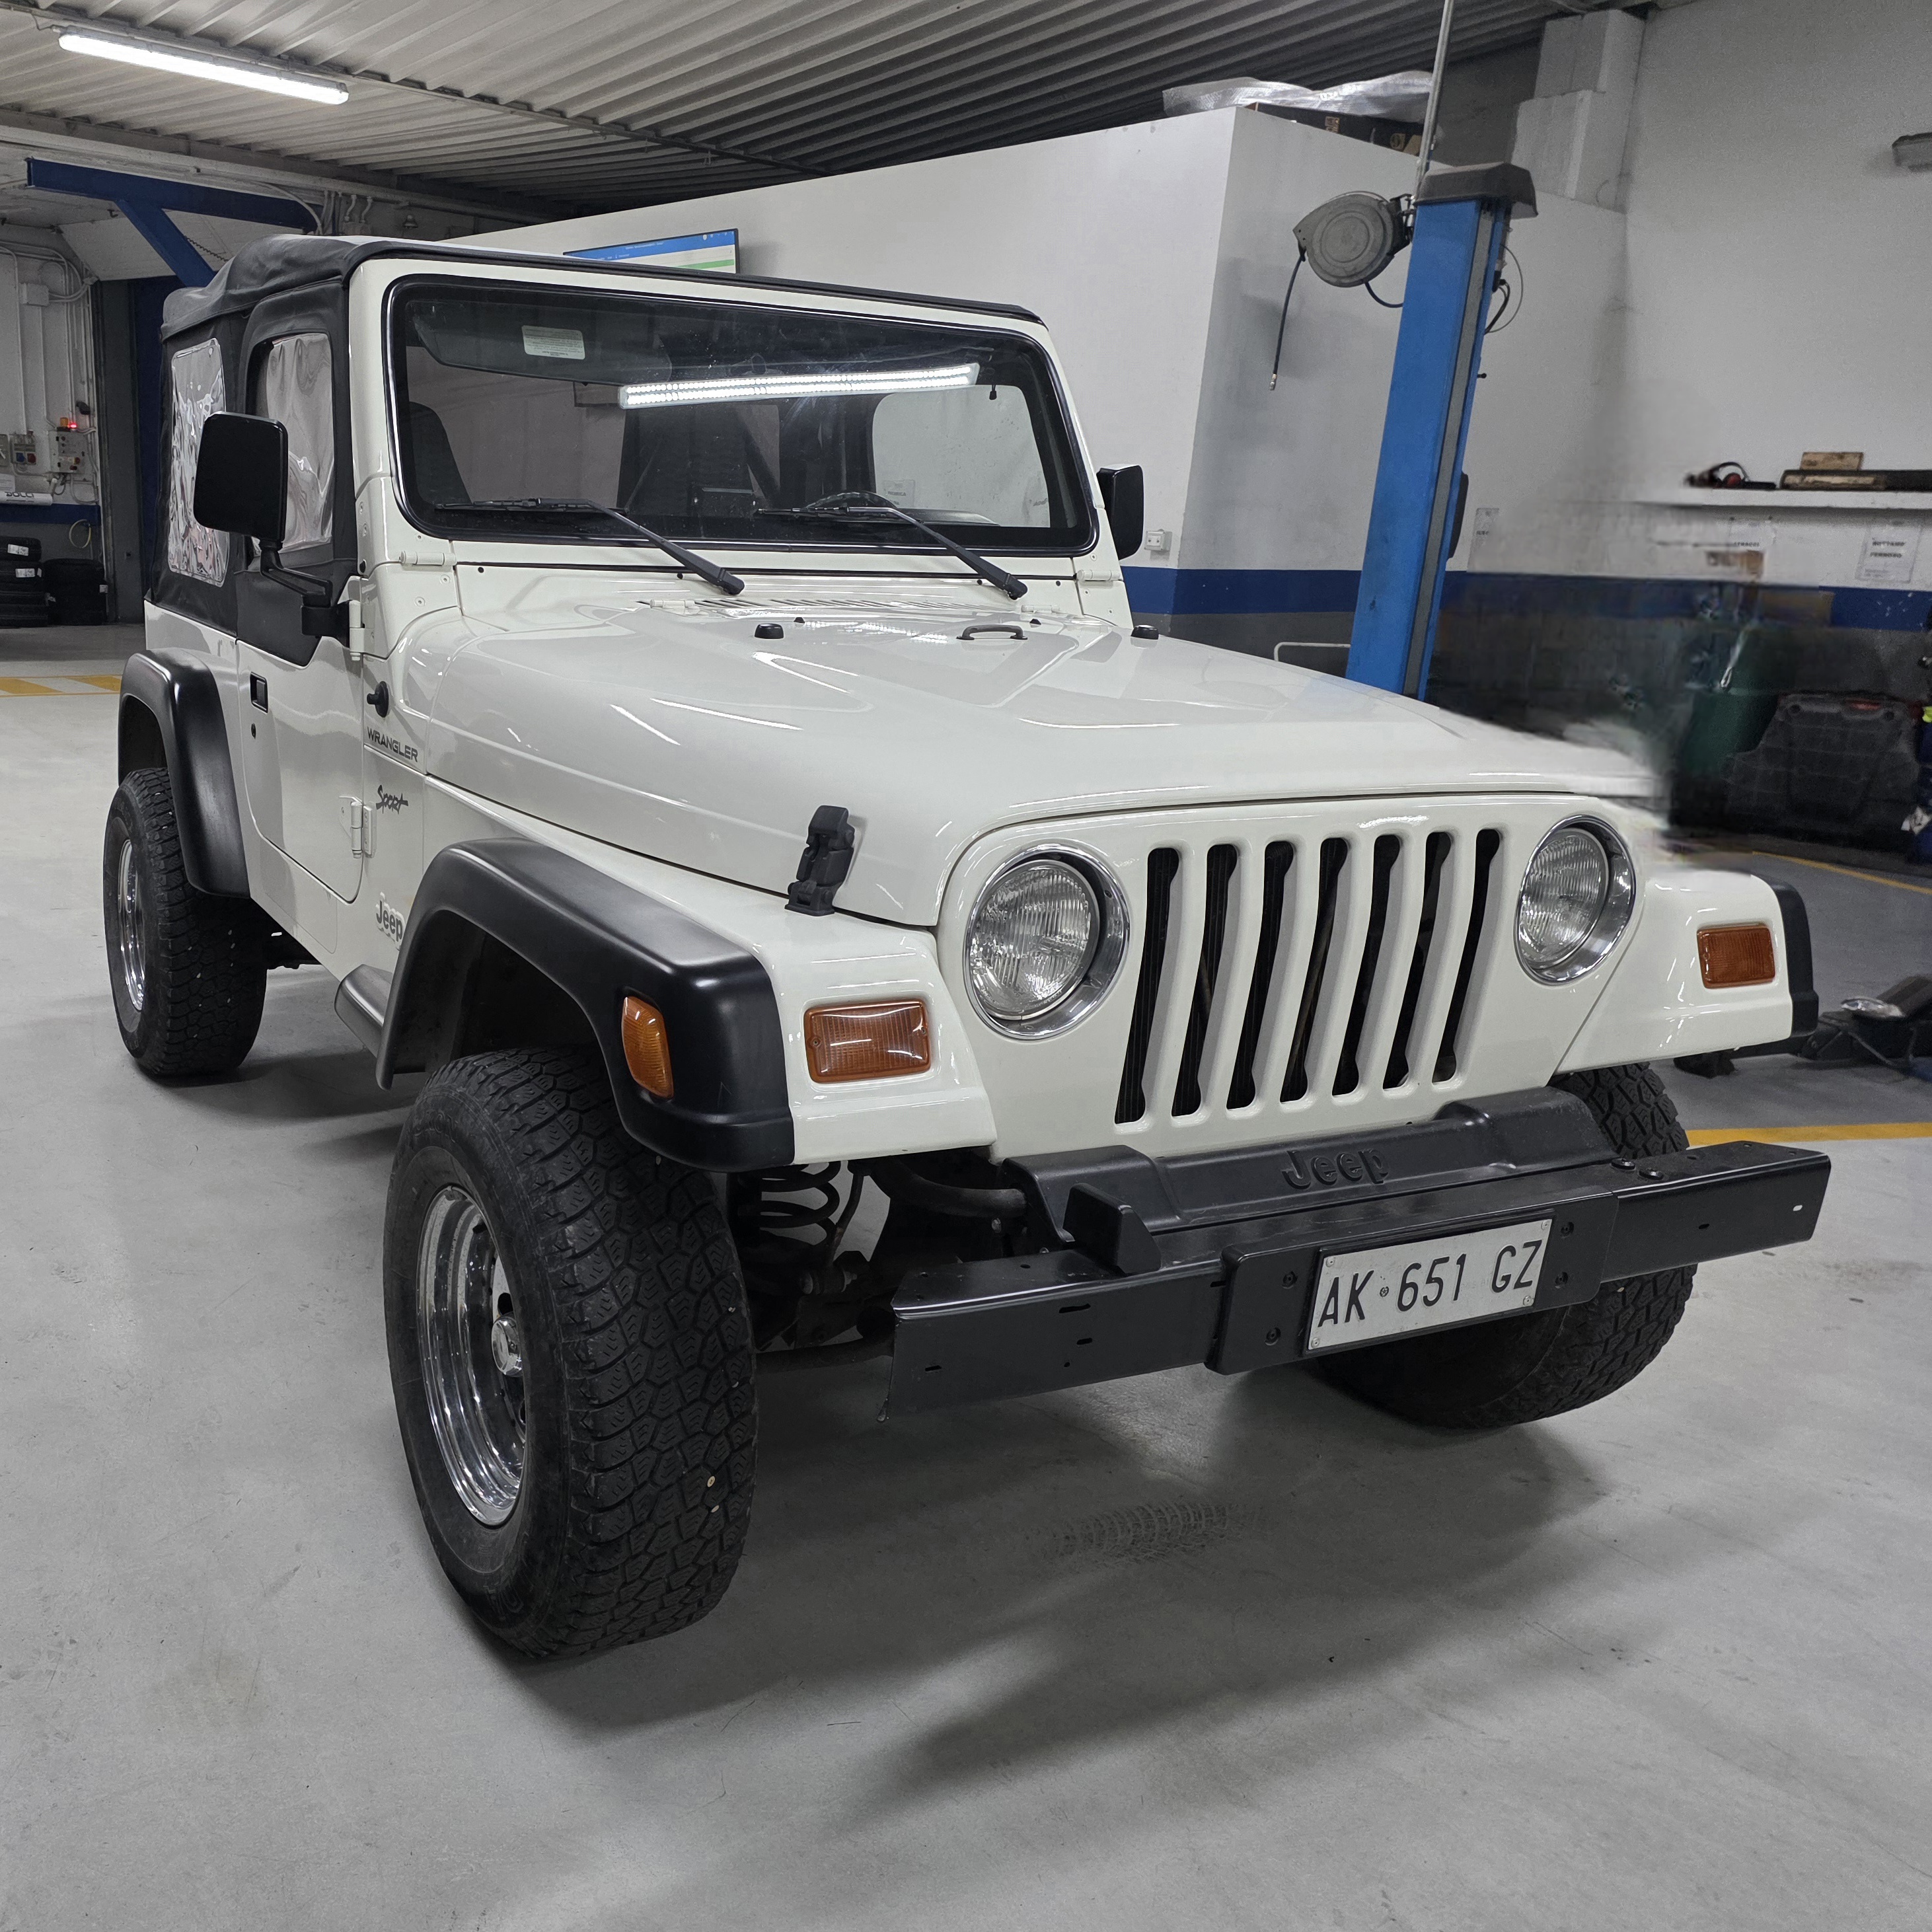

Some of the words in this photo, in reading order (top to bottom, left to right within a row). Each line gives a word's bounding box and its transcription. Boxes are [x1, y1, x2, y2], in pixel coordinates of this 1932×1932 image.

[367, 726, 418, 762] WRANGLER
[375, 785, 408, 814] Sport
[376, 900, 403, 942] Jeep
[1281, 1148, 1389, 1189] Jeep
[1318, 1270, 1374, 1327] AK
[1397, 1253, 1467, 1312] 651
[1491, 1240, 1543, 1293] GZ
